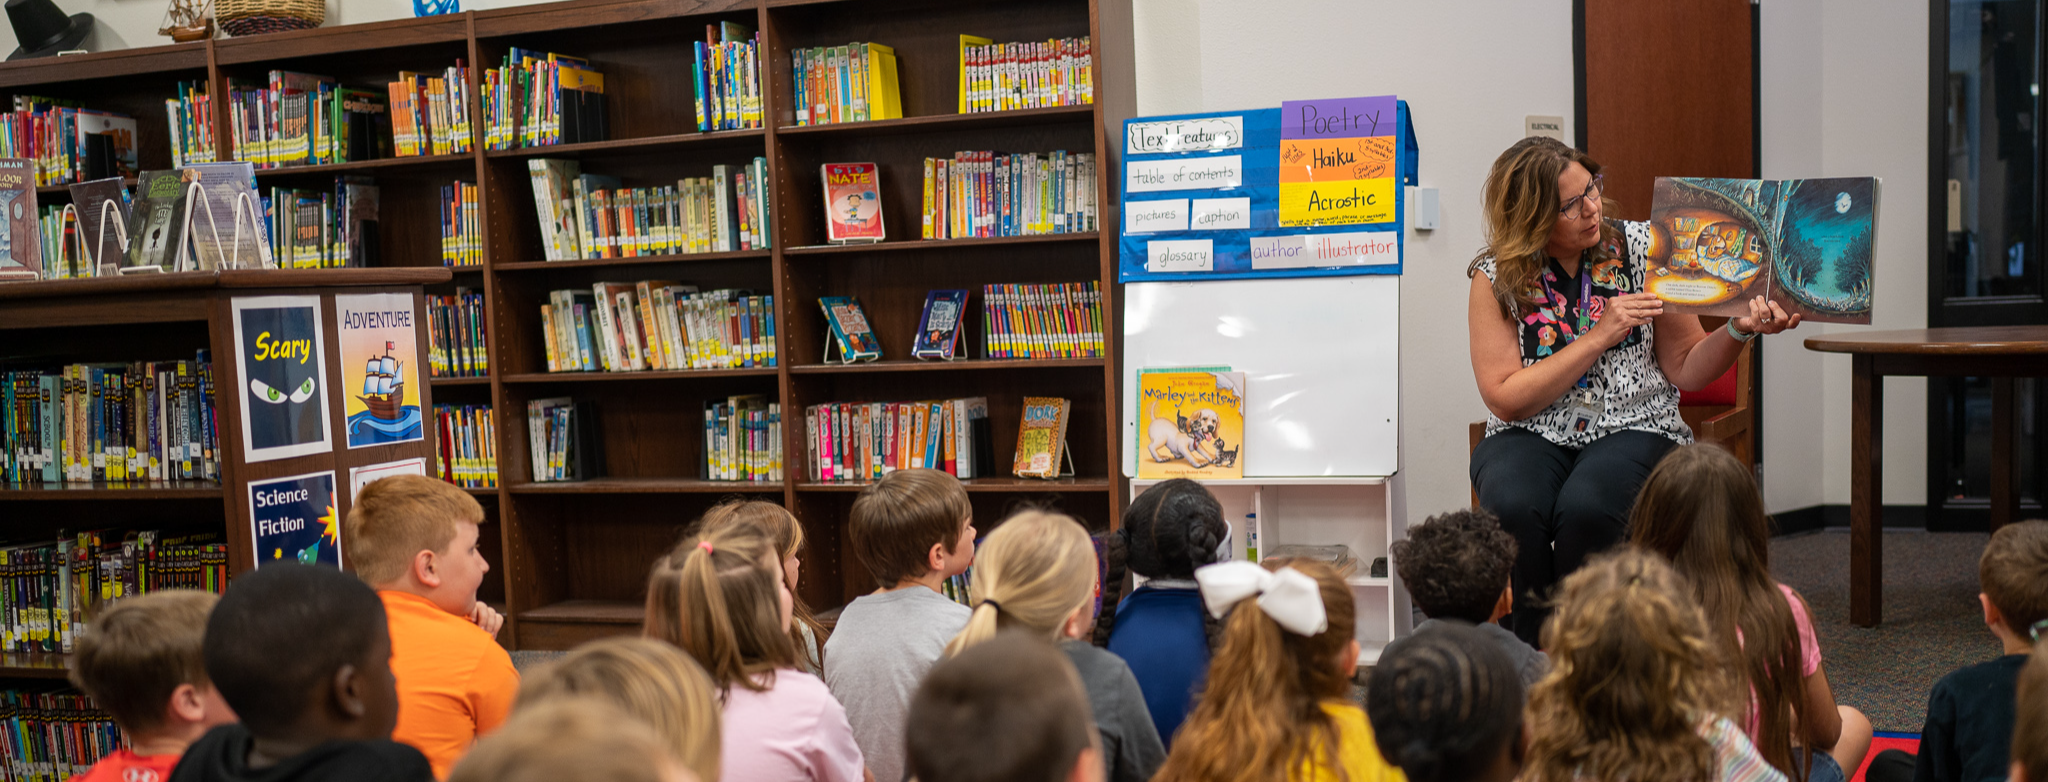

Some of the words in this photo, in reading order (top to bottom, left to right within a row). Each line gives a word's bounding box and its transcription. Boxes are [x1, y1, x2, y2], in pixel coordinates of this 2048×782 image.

[1302, 105, 1380, 137] Poetry
[0, 161, 24, 169] MAN
[1313, 147, 1358, 169] Haiku
[829, 173, 871, 185] NATE
[1133, 168, 1165, 184] table
[1173, 165, 1186, 182] of
[1189, 167, 1234, 181] contents
[1308, 187, 1377, 212] Acrostic
[1135, 209, 1177, 222] pictures
[1198, 208, 1240, 225] caption
[1159, 247, 1207, 267] glossary
[1253, 241, 1303, 258] author
[1318, 237, 1395, 260] illustrator
[344, 309, 411, 329] ADVENTURE
[254, 331, 311, 365] Scary
[1144, 386, 1187, 408] Marley
[1198, 392, 1240, 408] Kittens
[147, 391, 155, 440] NIGHTMARE
[1024, 405, 1059, 421] DORK
[256, 488, 309, 508] Science
[259, 517, 305, 537] Fiction
